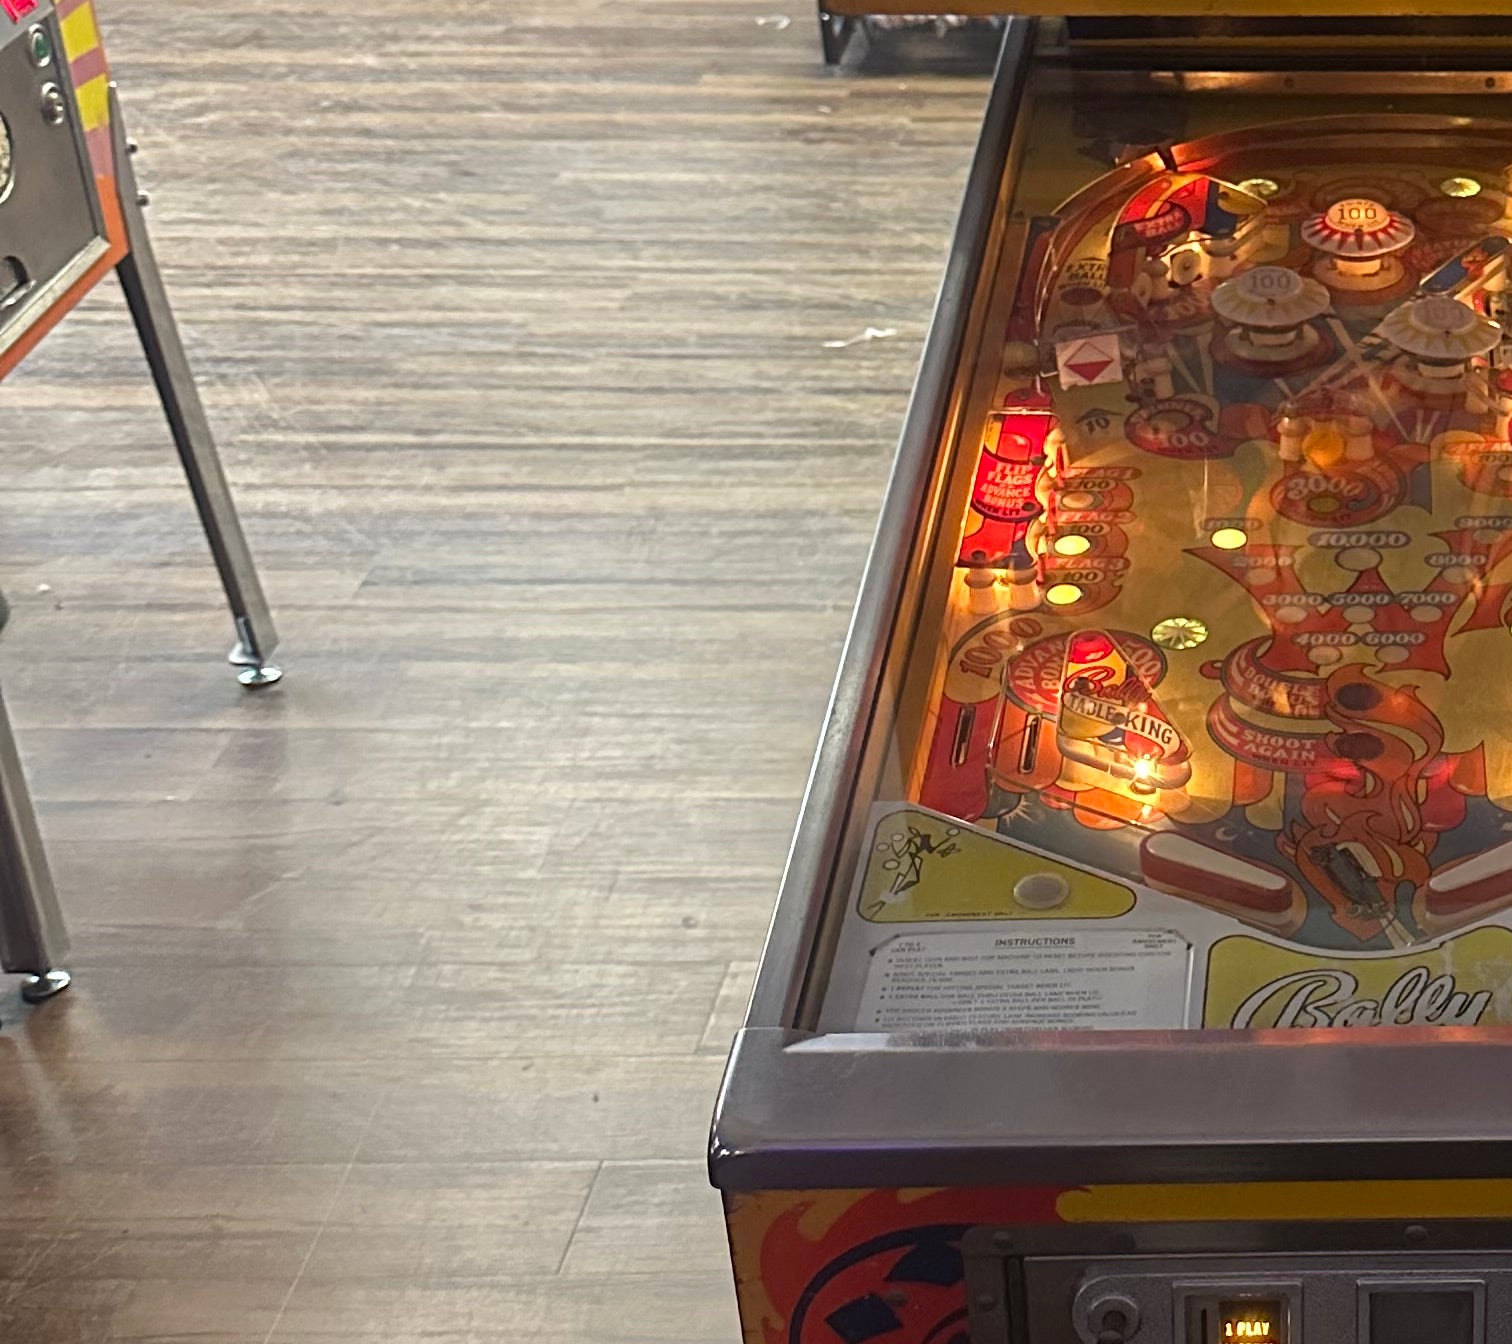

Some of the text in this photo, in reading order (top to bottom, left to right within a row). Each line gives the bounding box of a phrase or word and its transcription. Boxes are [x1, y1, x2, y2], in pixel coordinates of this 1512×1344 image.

[1336, 205, 1379, 222] 100
[1250, 271, 1291, 290] 100
[986, 471, 1034, 486] FLAGS
[1287, 473, 1363, 499] 3000
[1314, 531, 1408, 547] 10,000
[1262, 593, 1323, 606] 3000
[1330, 592, 1389, 606] 5000
[1399, 591, 1456, 605] 7000
[1294, 631, 1355, 646] 4000
[1365, 631, 1423, 646] 6000
[959, 617, 1043, 679] 1000
[1124, 711, 1174, 745] KING
[1242, 729, 1318, 750] SHOOT
[1243, 744, 1317, 761] AGAIN
[994, 936, 1076, 947] INSTRUCTIONS
[1230, 966, 1493, 1029] Bally
[1225, 1321, 1270, 1336] 1 PLAY
